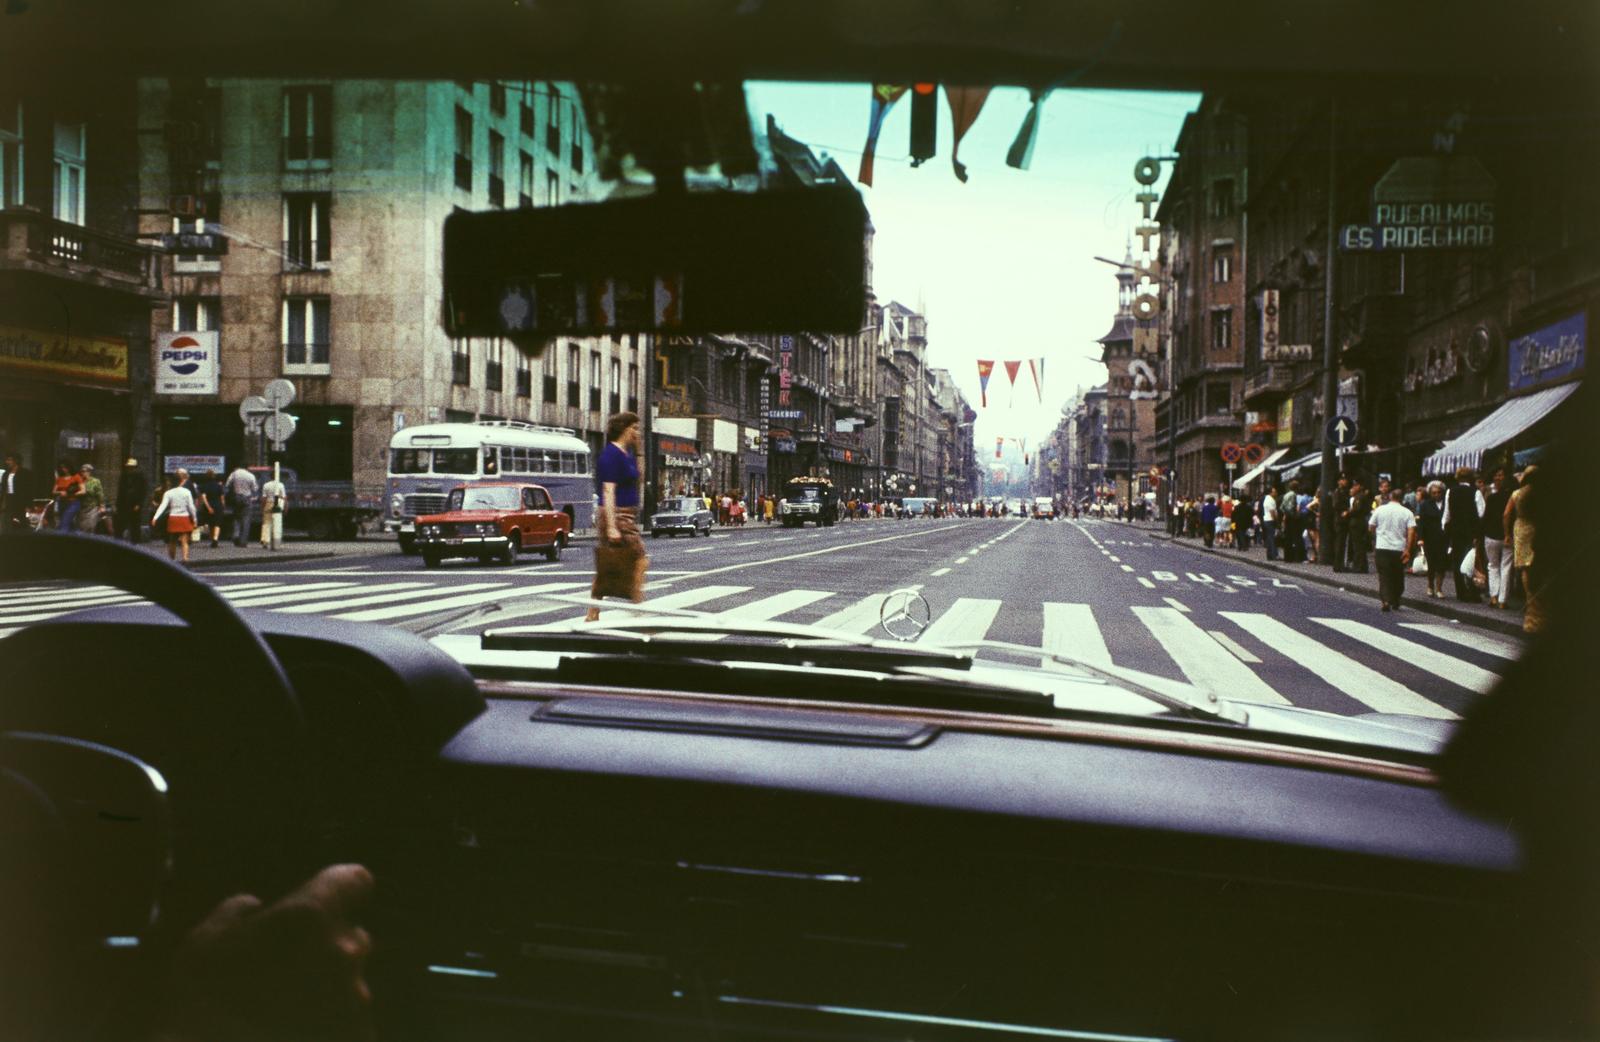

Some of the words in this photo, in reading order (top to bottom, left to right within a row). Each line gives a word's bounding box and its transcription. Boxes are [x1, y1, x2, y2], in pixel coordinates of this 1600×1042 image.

[1376, 203, 1494, 225] RUGALMAS
[1132, 156, 1161, 353] OTTHON
[162, 351, 207, 361] PEPSI
